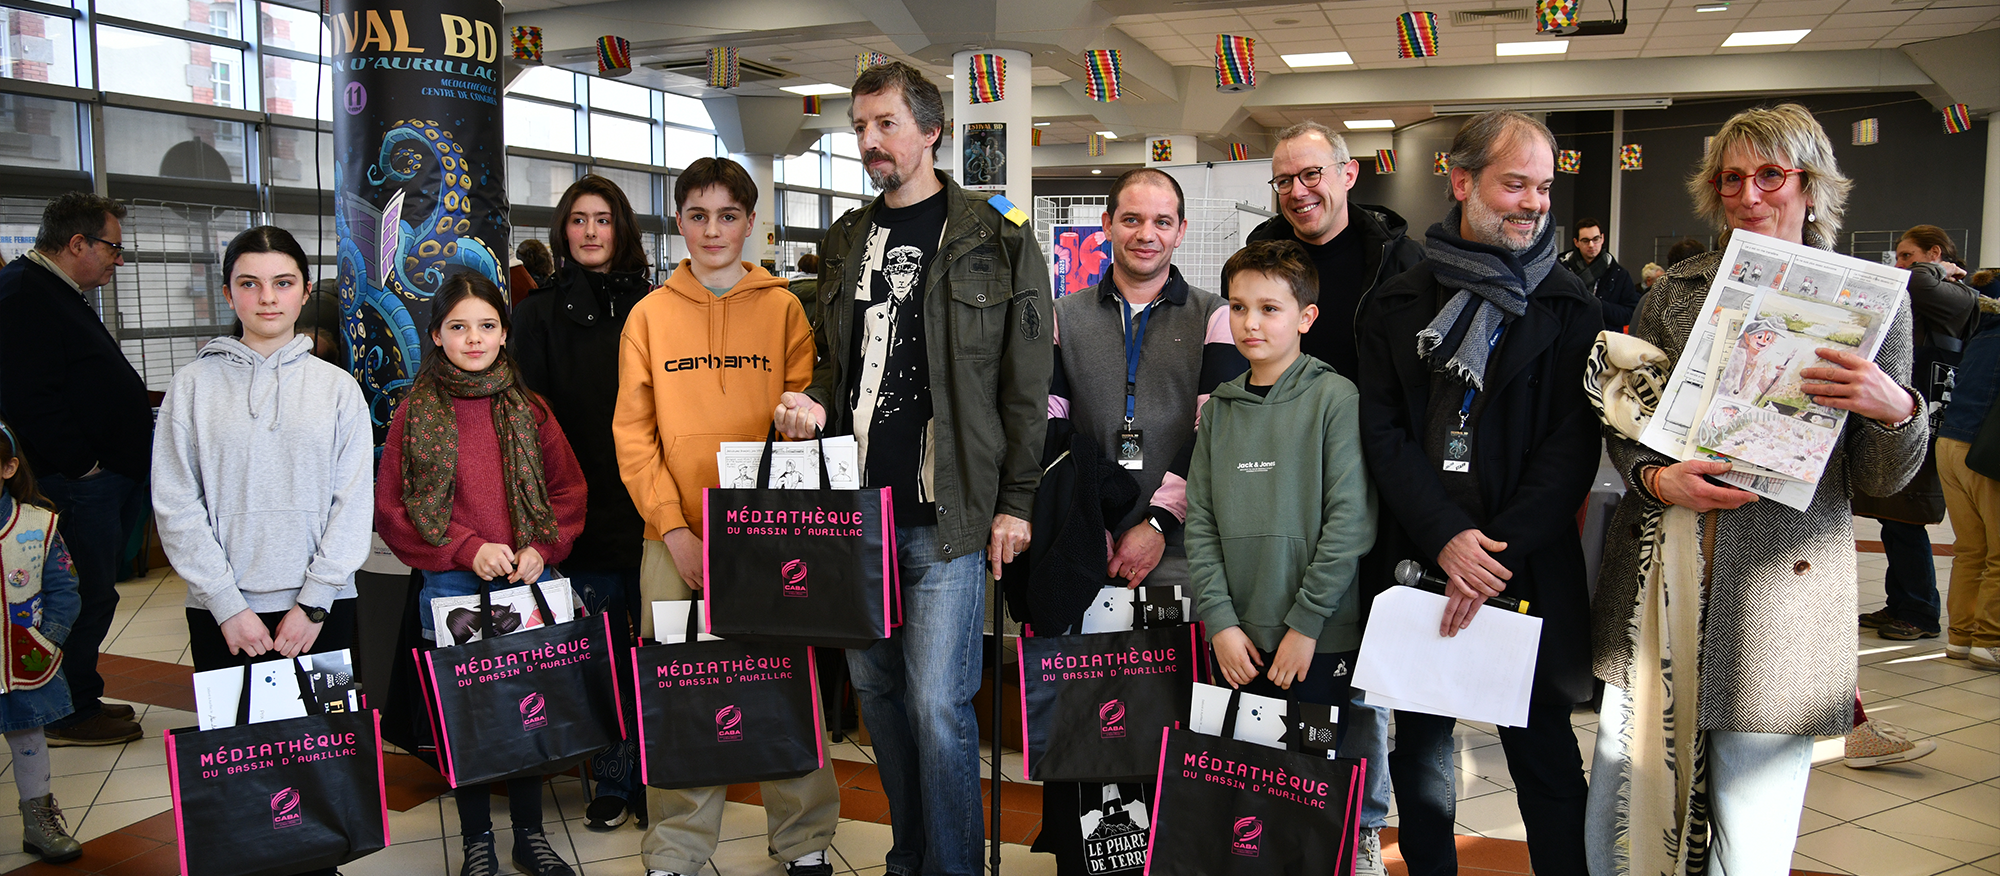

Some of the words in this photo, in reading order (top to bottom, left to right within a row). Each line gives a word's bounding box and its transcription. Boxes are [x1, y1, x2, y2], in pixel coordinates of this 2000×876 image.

[331, 10, 425, 56] IVAL
[440, 13, 497, 64] BD
[351, 56, 497, 82] D'AURILLAC
[346, 86, 362, 106] 11
[421, 87, 456, 98] CENTRE
[457, 91, 469, 100] DE
[664, 354, 770, 373] carhartt
[1237, 461, 1254, 470] Jack
[726, 506, 863, 524] MÉDIATHÈQUE
[727, 527, 740, 535] DU
[746, 527, 787, 535] BASSIN
[794, 526, 863, 537] D'AURILLAC
[454, 638, 590, 677] MÉDIATHÈQUE
[657, 655, 792, 678] MÉDIATHÈQUE
[1041, 647, 1176, 670] MÉDIATHÈQUE
[458, 678, 472, 687] DU
[479, 668, 520, 683] BASSIN
[527, 652, 591, 673] D'AURILLAC
[658, 680, 672, 688] DU
[679, 677, 720, 687] BASSIN
[726, 671, 793, 684] D'AURILLAC
[1042, 673, 1056, 682] DU
[1063, 671, 1104, 681] BASSIN
[1110, 664, 1177, 677] D'AURILLAC
[524, 715, 546, 725] CABA
[200, 732, 356, 767] MÉDIATHÈQUE
[202, 769, 219, 779] DU
[227, 759, 274, 775] BASSIN
[282, 747, 357, 766] D'AURILLAC
[1184, 751, 1329, 797] MÉDIATHÈQUE
[1183, 770, 1198, 779] DU
[1204, 773, 1245, 790] BASSIN
[1253, 784, 1326, 809] D'AURILLAC
[274, 813, 300, 823] CABA
[1088, 842, 1104, 857] LE
[1106, 832, 1147, 855] PHARE
[1233, 841, 1258, 850] CABA
[1090, 858, 1107, 872] DE
